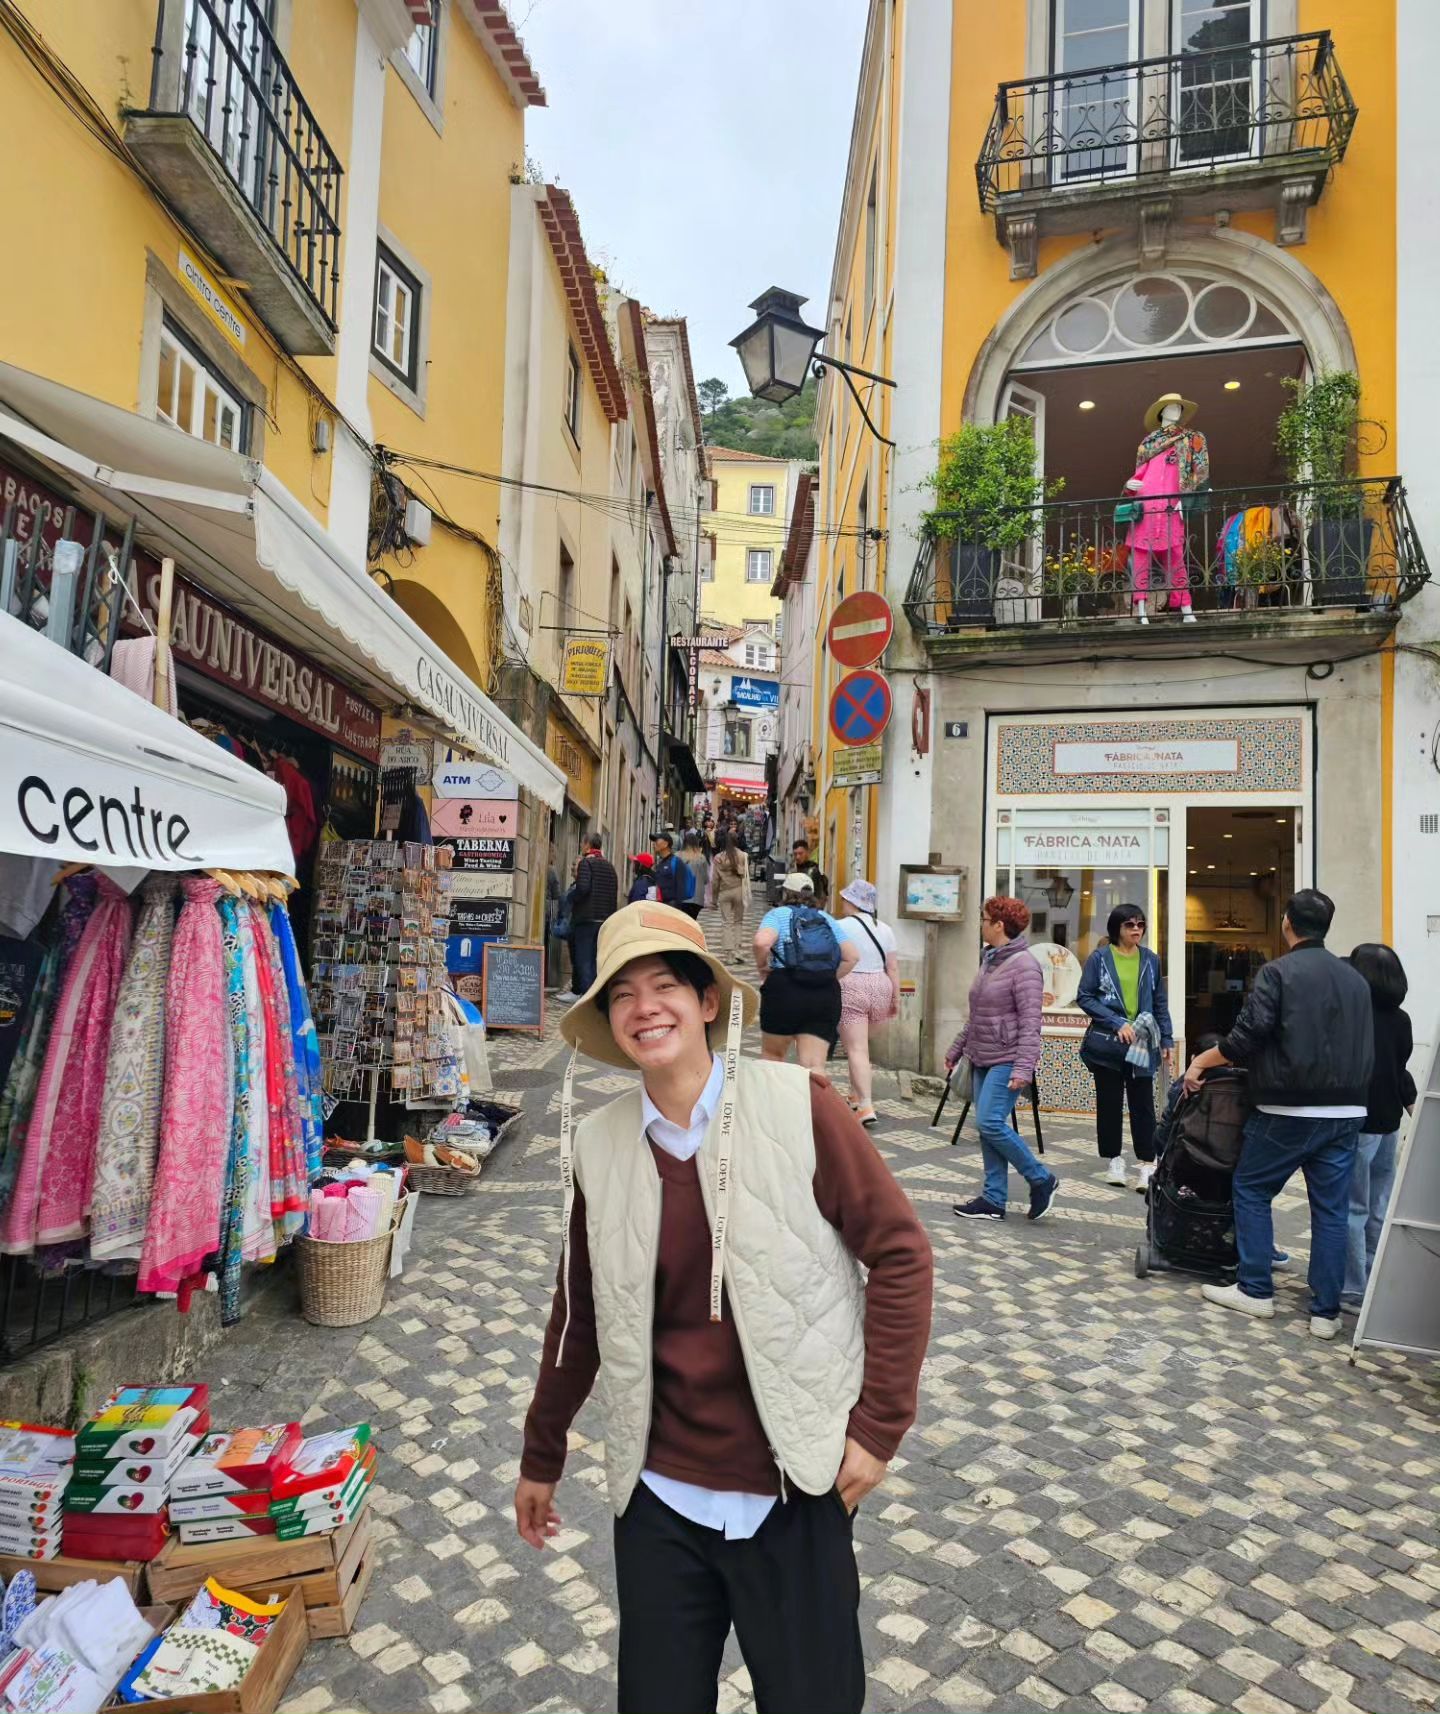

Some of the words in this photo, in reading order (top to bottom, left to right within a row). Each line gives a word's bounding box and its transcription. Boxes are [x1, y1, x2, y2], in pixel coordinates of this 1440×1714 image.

[670, 636, 728, 648] RESTAURANTE
[952, 723, 961, 736] 6
[443, 776, 471, 784] ATM
[18, 775, 204, 862] centre
[457, 839, 510, 852] TABERNA
[1023, 832, 1092, 848] FÁBRICA
[1097, 835, 1141, 848] NATA
[731, 994, 740, 1028] LOEWE
[726, 1048, 737, 1082] LOEWE
[562, 1102, 570, 1134] LOEWE
[721, 1102, 733, 1137] LOEWE
[561, 1156, 572, 1189] LOEWE
[718, 1158, 728, 1192] LOEWE
